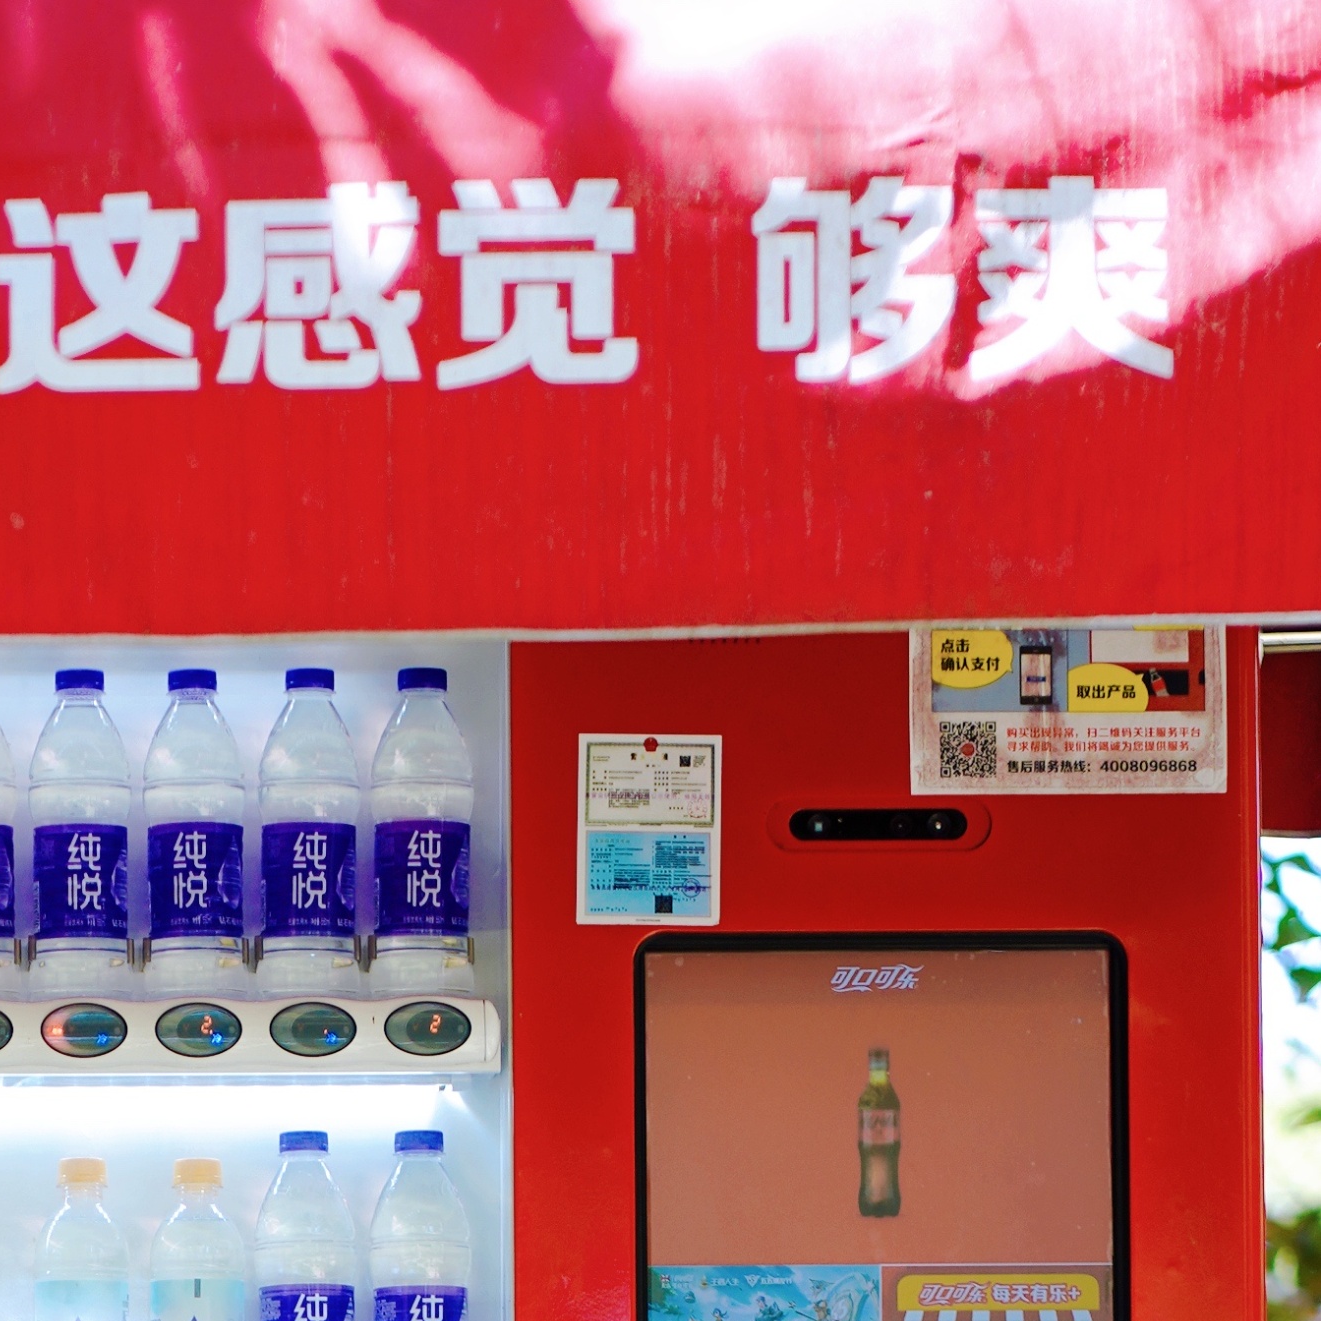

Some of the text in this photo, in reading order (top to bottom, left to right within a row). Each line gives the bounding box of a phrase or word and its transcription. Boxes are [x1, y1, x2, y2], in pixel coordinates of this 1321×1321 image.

[751, 176, 1175, 384] 够爽
[940, 639, 970, 653] 点击
[940, 657, 1000, 671] 确认支付
[1076, 685, 1136, 699] 取出产品
[67, 833, 101, 911] 纯悦
[173, 830, 208, 909] 纯悦
[291, 830, 327, 910] 纯悦
[407, 829, 442, 909] 纯悦
[830, 963, 925, 993] 可口可乐
[919, 1281, 1081, 1306] 可口可乐 每天有乐+
